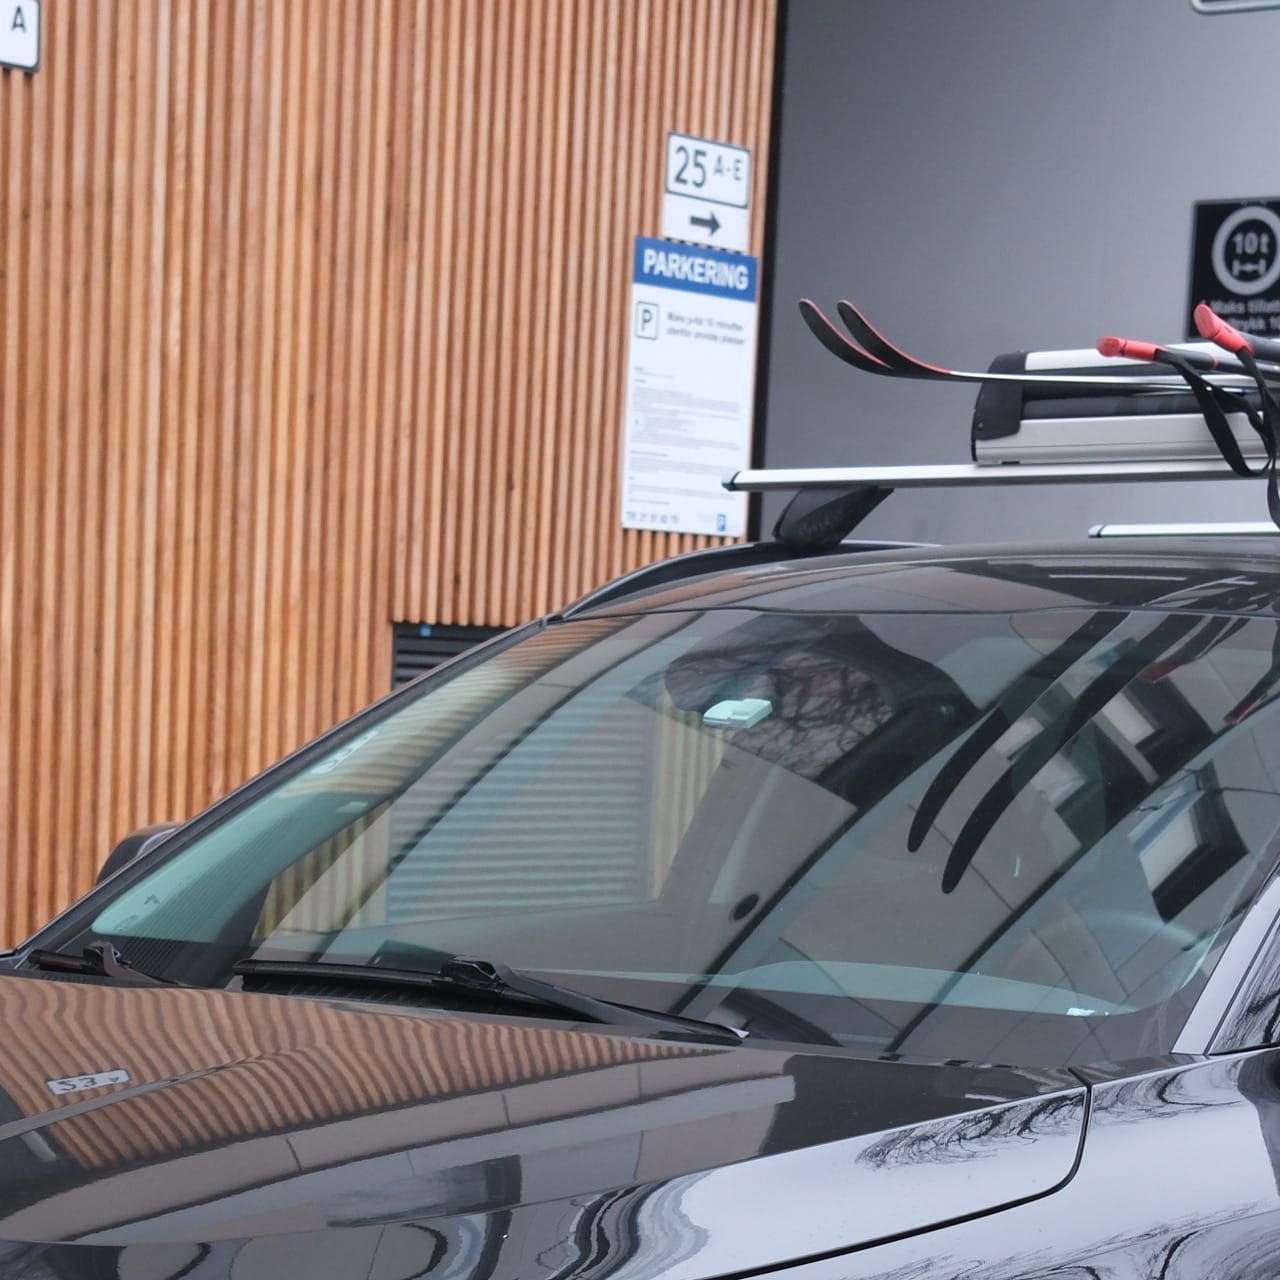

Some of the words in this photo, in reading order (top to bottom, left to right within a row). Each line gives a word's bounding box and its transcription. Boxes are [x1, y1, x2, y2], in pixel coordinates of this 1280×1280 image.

[11, 5, 27, 33] A
[674, 145, 707, 188] 25
[643, 248, 750, 291] PARKERING
[641, 308, 653, 332] P
